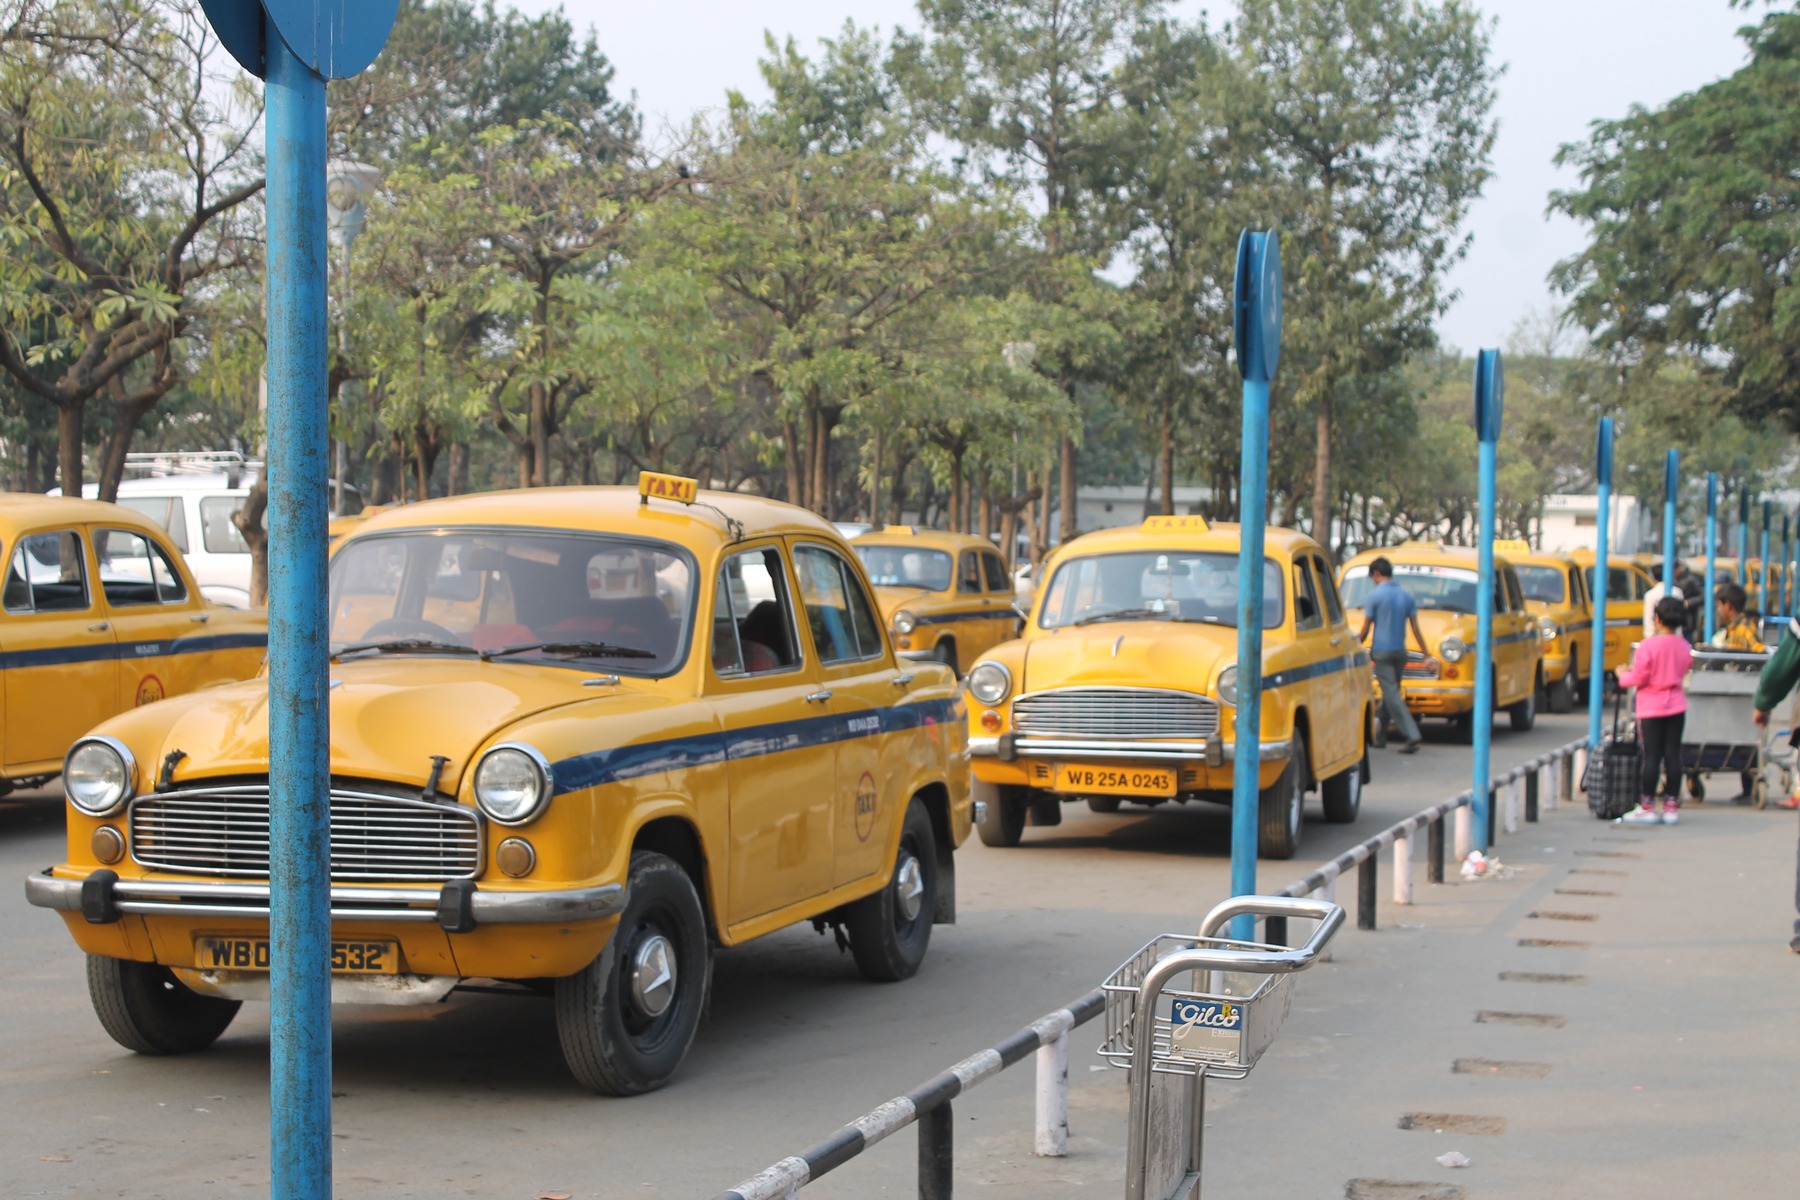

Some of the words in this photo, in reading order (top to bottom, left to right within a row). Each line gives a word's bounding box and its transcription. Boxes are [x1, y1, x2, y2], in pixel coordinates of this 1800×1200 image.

[647, 477, 690, 498] TAXI
[1151, 519, 1199, 527] TAXI
[1067, 771, 1095, 786] WB
[1098, 772, 1128, 787] 25A
[1132, 773, 1169, 790] 0243
